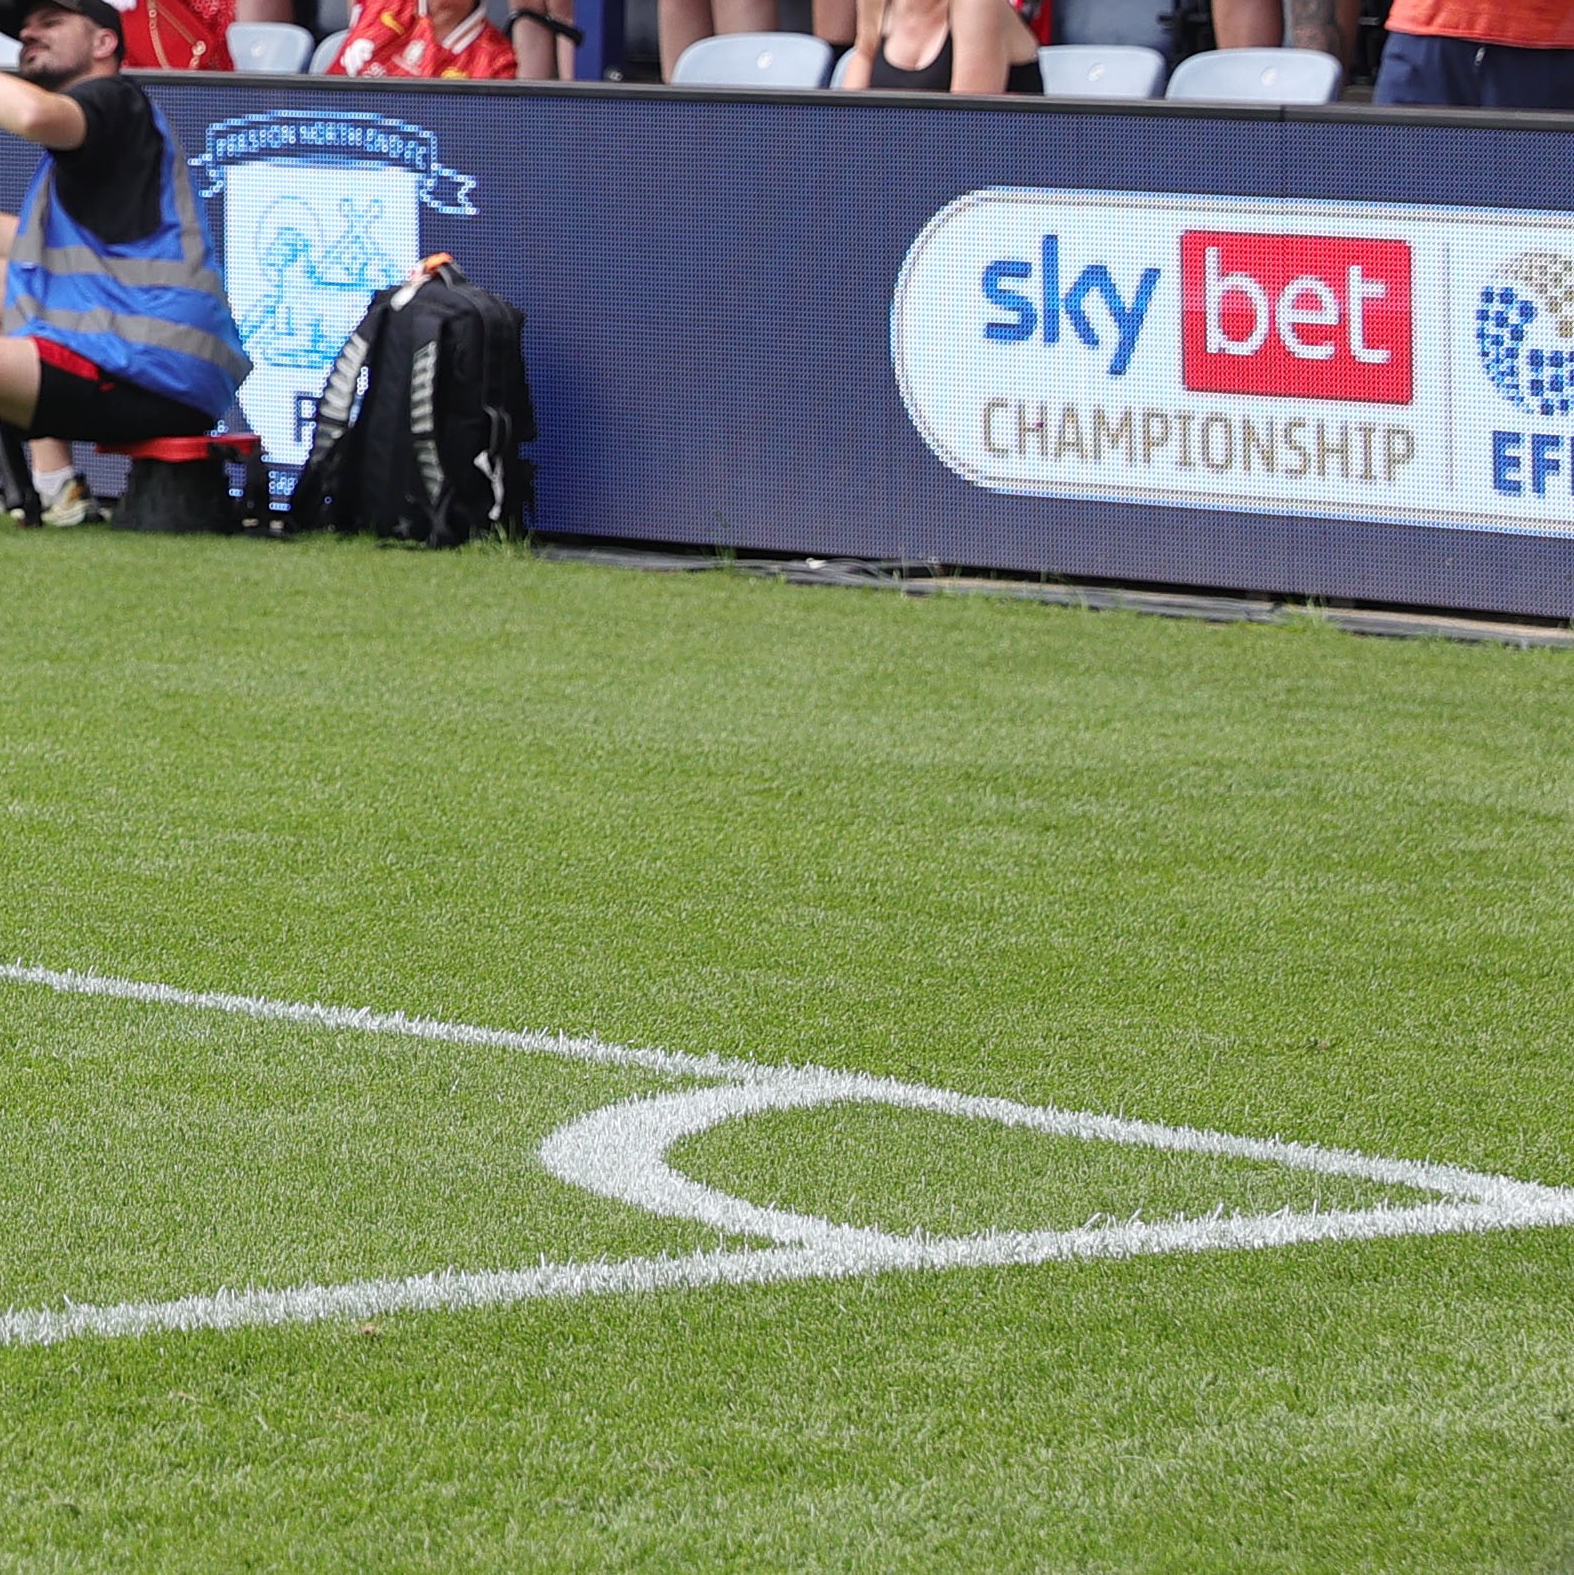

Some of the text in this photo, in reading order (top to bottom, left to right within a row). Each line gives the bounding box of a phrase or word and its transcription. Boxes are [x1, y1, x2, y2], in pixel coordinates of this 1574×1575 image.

[981, 232, 1392, 377] sky bet
[981, 396, 1417, 483] CHAMPIONSHIP
[1491, 429, 1574, 499] EF
